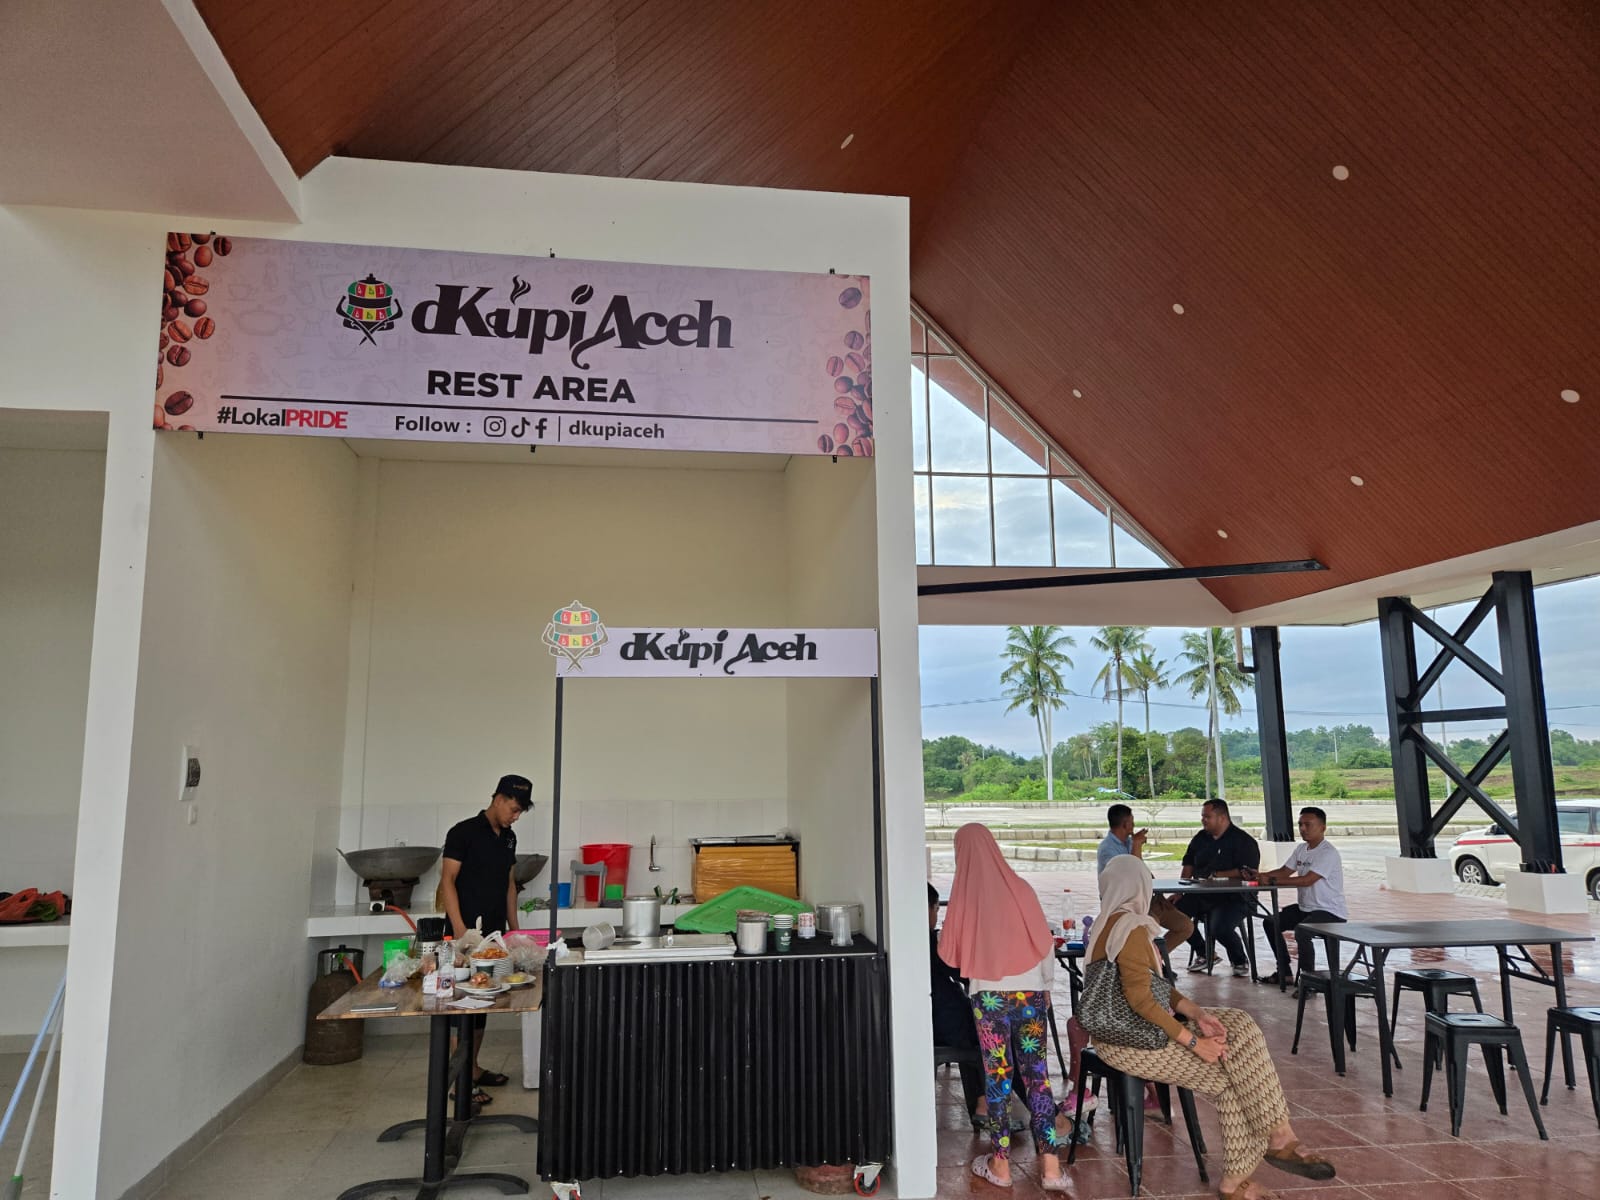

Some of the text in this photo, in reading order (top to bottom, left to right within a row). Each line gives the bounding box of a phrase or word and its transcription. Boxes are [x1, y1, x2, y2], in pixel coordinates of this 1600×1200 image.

[427, 370, 636, 404] REST AREA
[217, 406, 348, 429] #LokalPRIDE
[395, 415, 460, 433] Follow
[568, 420, 665, 440] dkupiaceh
